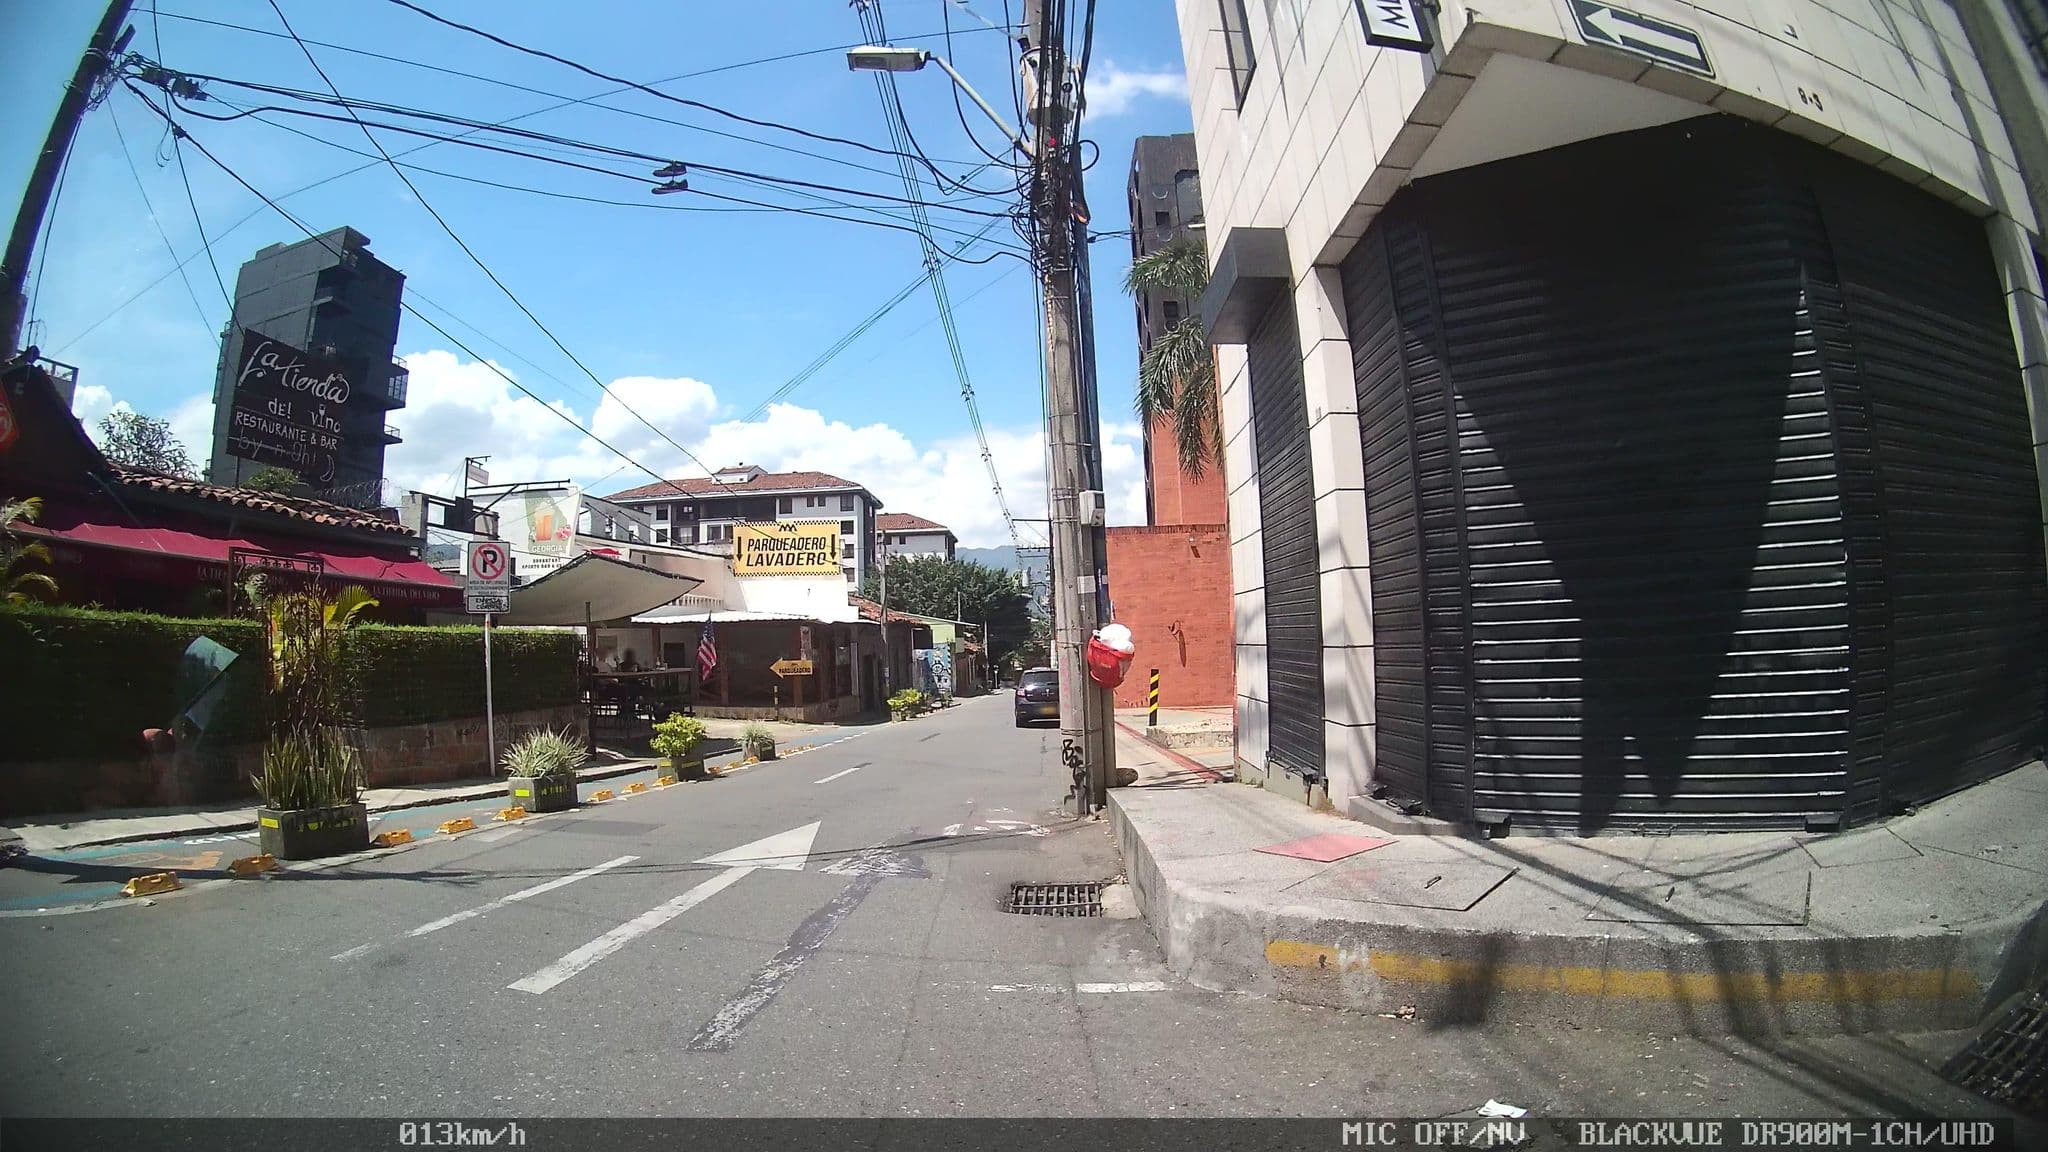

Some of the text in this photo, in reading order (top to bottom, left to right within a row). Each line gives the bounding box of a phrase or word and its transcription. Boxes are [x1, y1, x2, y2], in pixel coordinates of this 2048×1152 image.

[235, 411, 338, 450] RESTAURANTE & BAR
[747, 537, 827, 552] PARQUEADERO
[746, 552, 827, 567] LAVADERO
